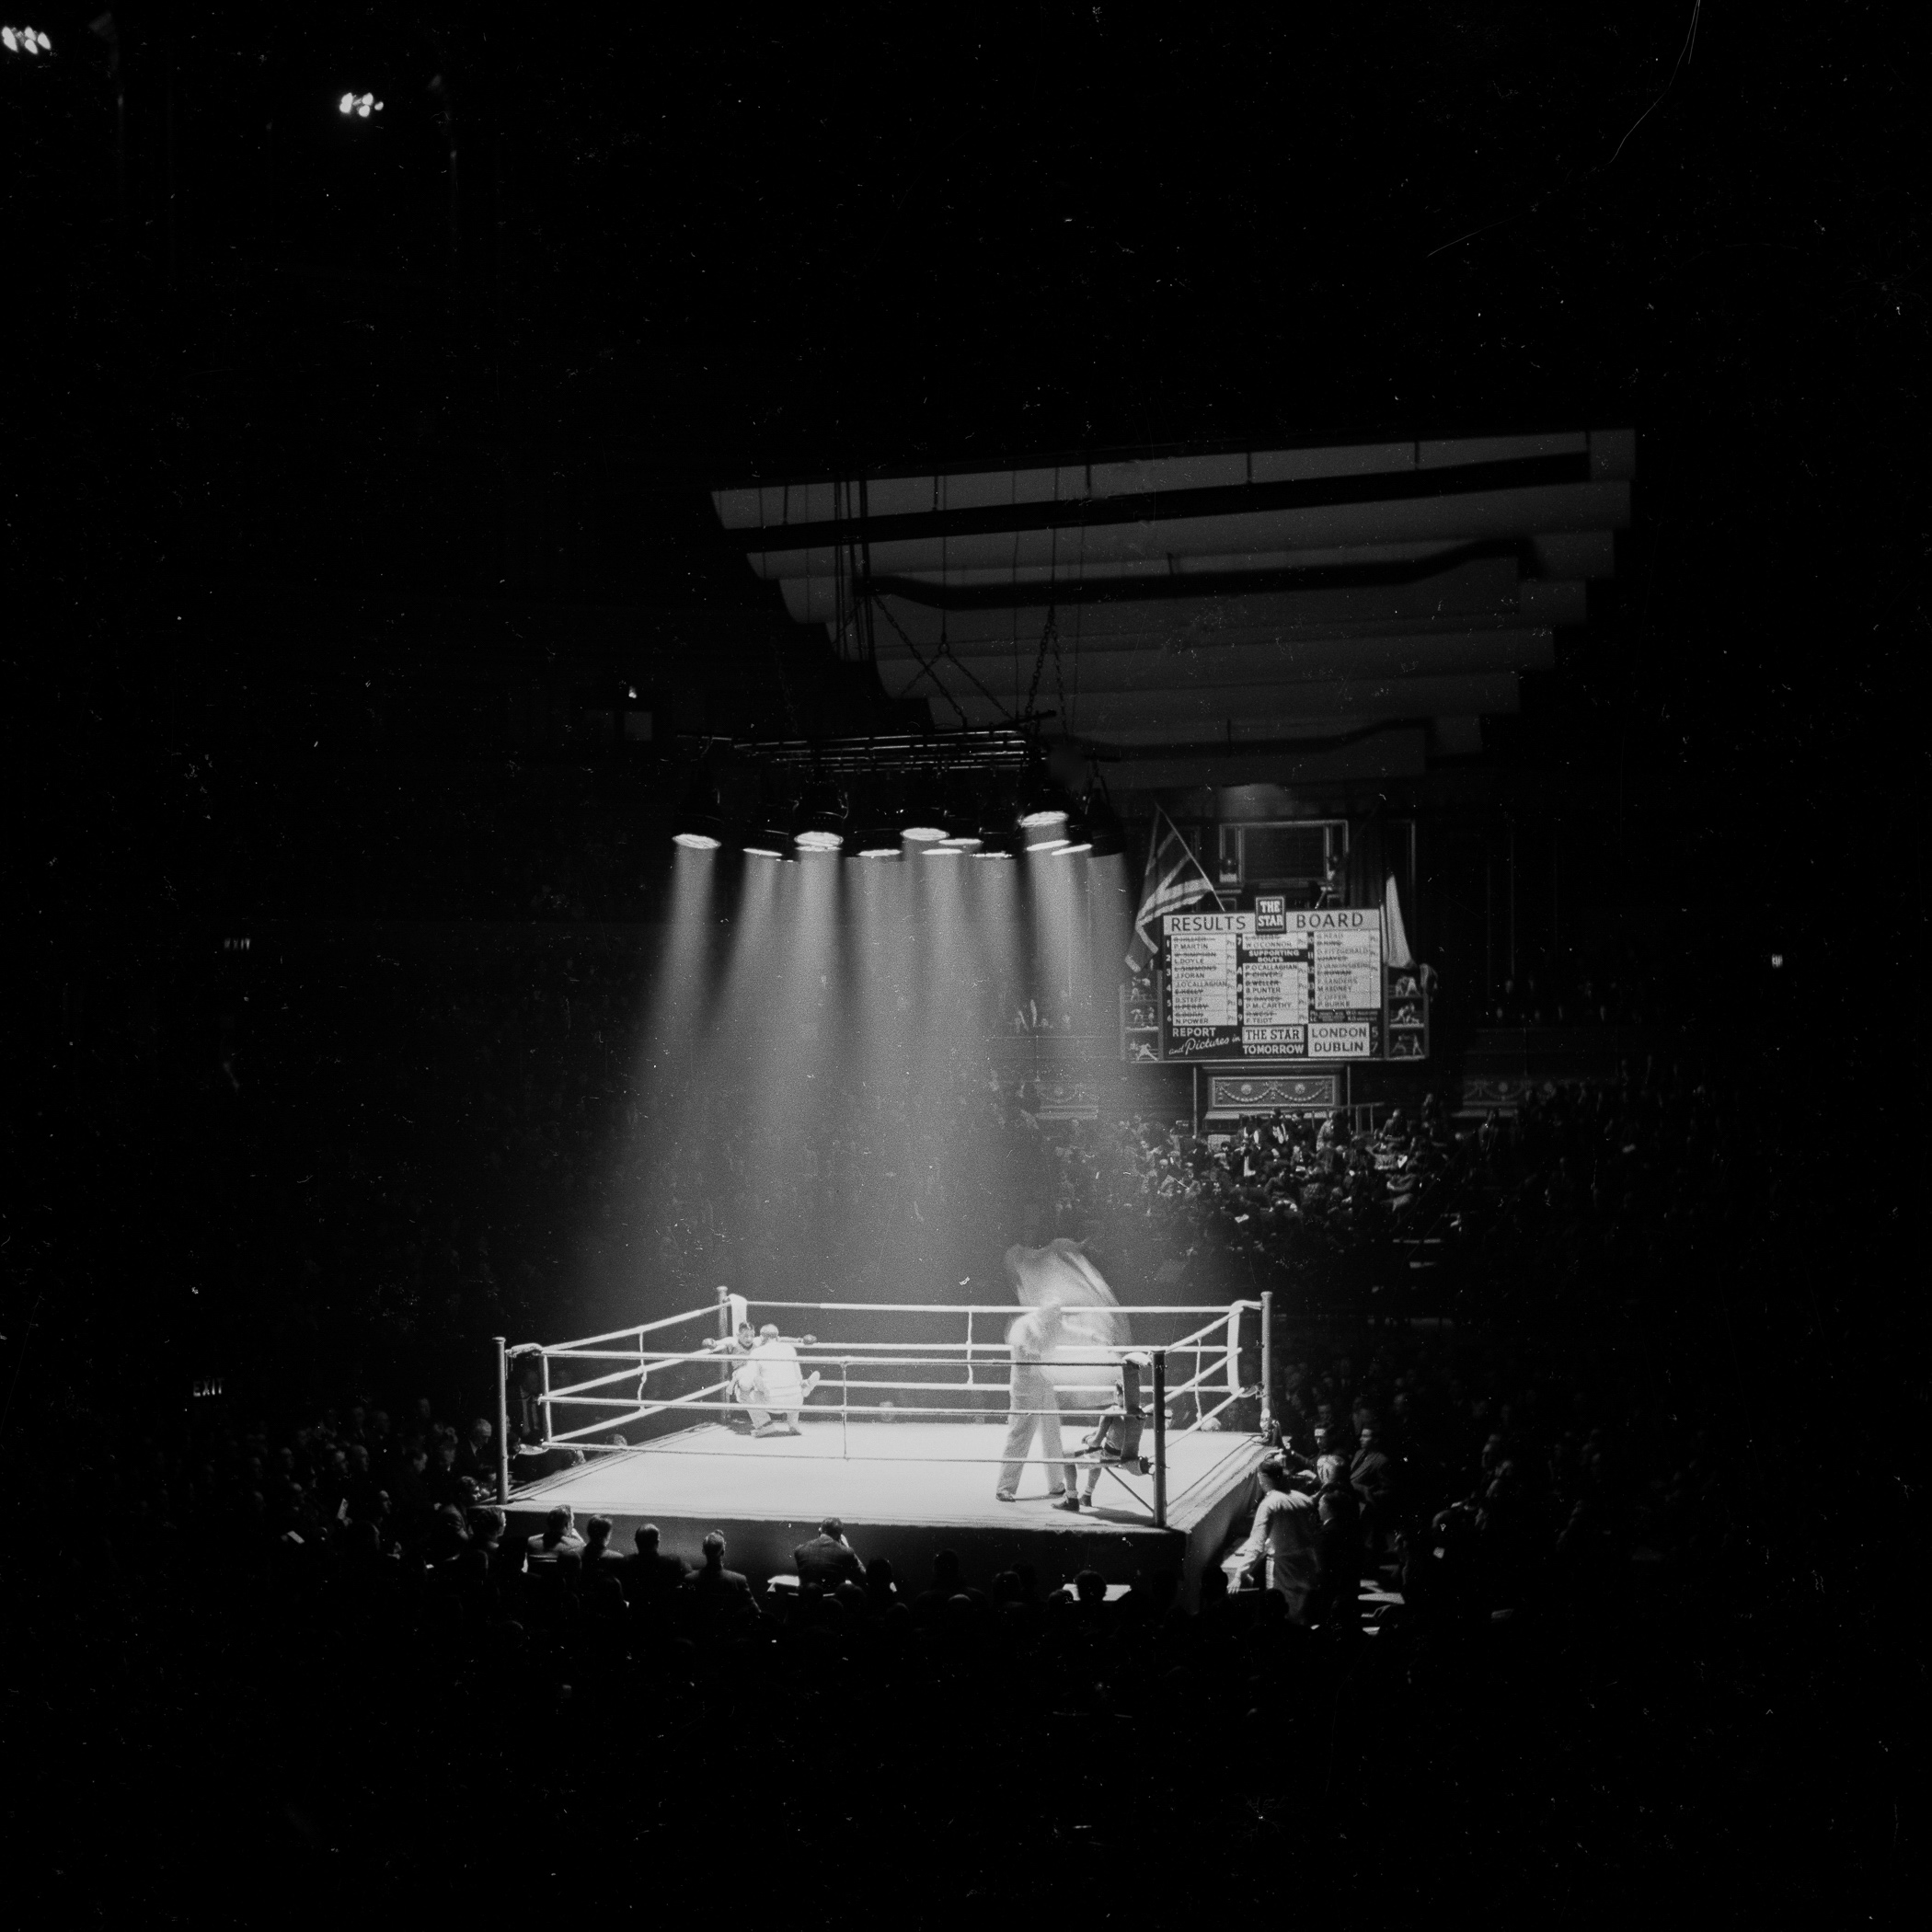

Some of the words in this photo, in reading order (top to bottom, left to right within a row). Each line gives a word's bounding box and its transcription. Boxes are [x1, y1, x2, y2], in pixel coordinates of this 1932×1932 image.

[1260, 901, 1281, 913] THE
[1171, 916, 1246, 931] RESULTS
[1297, 913, 1363, 927] BOARD
[1259, 915, 1282, 927] STAR
[224, 937, 251, 951] EXIT
[1167, 968, 1171, 976] 3
[1172, 1027, 1215, 1038] REPORT
[1246, 1029, 1267, 1041] THE
[1270, 1028, 1300, 1040] STAR
[1312, 1027, 1366, 1038] LONDON
[1371, 1026, 1378, 1038] 5
[1168, 1046, 1185, 1055] and
[1185, 1037, 1229, 1055] Pictures
[1232, 1033, 1240, 1043] in
[1242, 1044, 1304, 1054] TOMORROW
[1314, 1041, 1363, 1052] DUBLIN
[193, 1378, 224, 1397] EXIT
